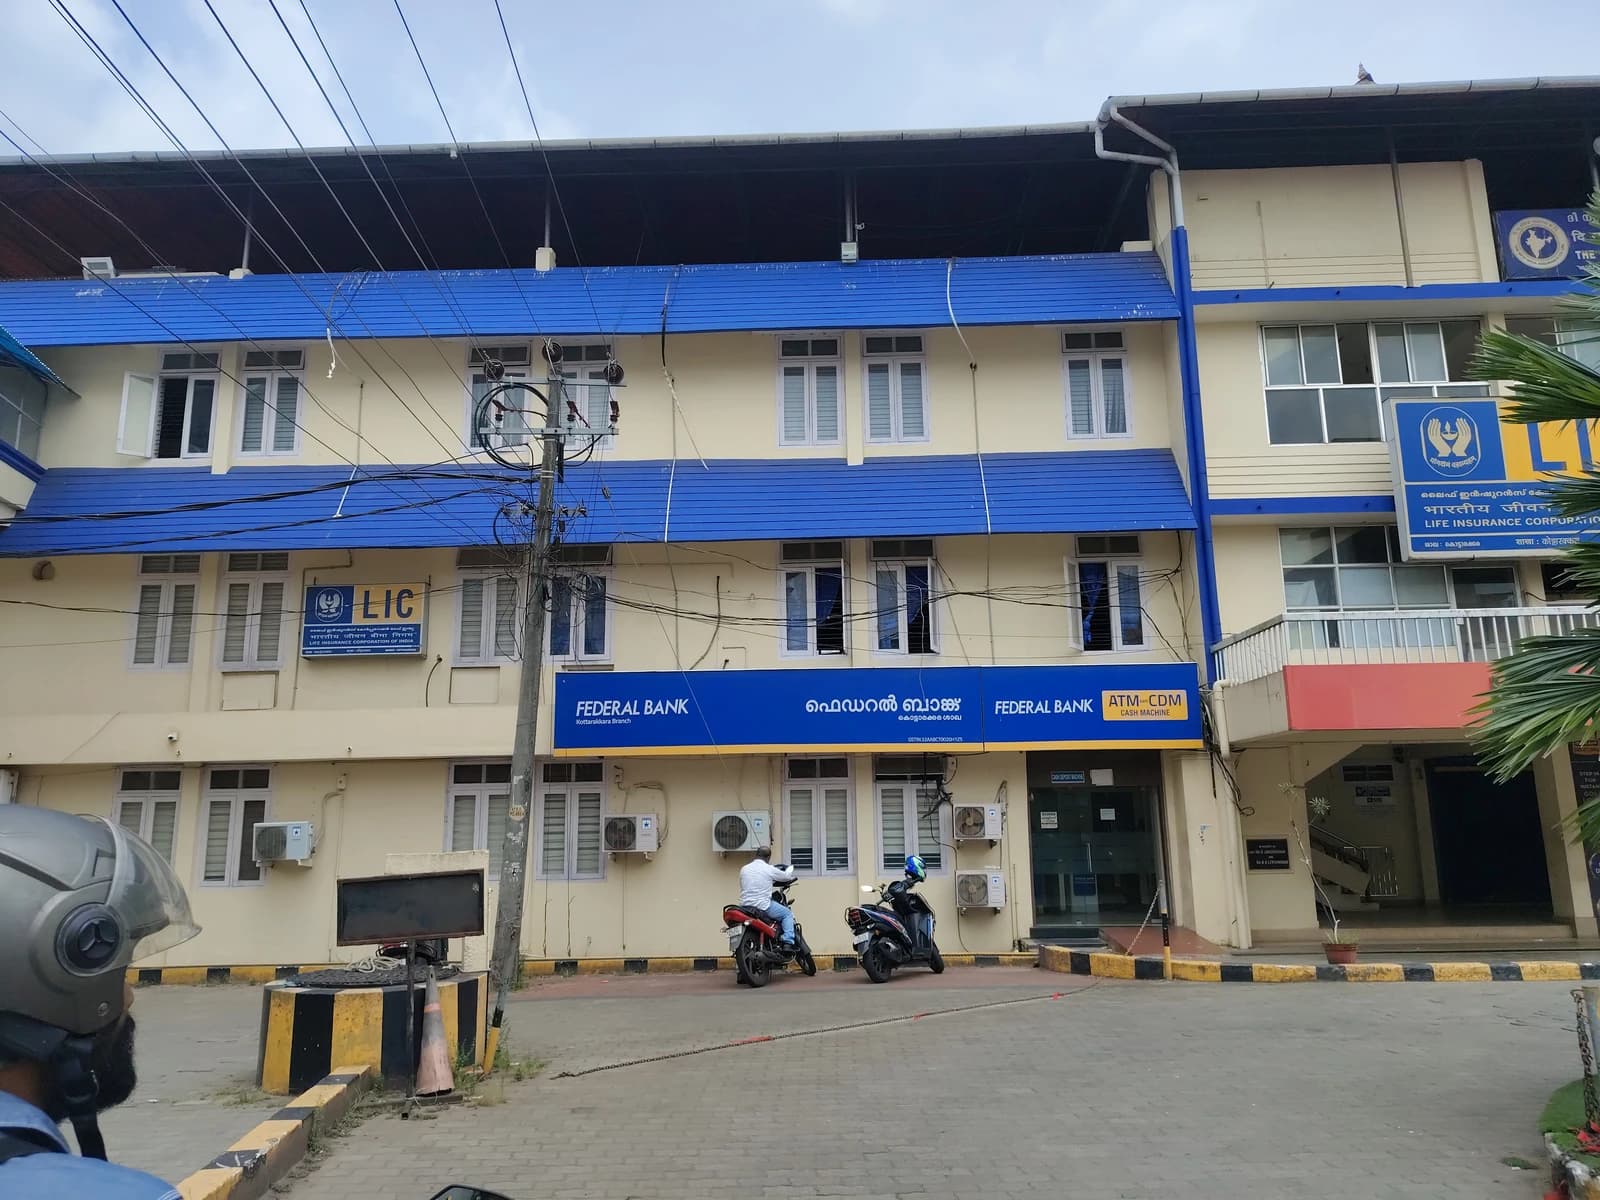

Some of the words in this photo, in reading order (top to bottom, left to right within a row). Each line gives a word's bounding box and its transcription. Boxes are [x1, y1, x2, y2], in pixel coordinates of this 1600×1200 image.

[1575, 250, 1596, 260] THE
[1527, 417, 1594, 472] LI
[1424, 502, 1490, 515] भारतीय
[1425, 519, 1449, 529] LIFE
[1453, 517, 1522, 528] INSURANCE
[1525, 516, 1600, 526] CORPORATIO
[363, 588, 413, 619] LIC
[575, 700, 640, 717] FEDERAL
[643, 698, 689, 715] BANK
[805, 694, 898, 713] ഫെഡറൽ
[902, 697, 962, 712] ബാങ്ക്
[995, 700, 1051, 715] FEDERAL
[1054, 698, 1094, 714] BANK
[1108, 694, 1140, 707] ATM
[1149, 694, 1182, 707] CDM
[1120, 708, 1138, 717] CASH
[1139, 708, 1171, 717] MACHINE
